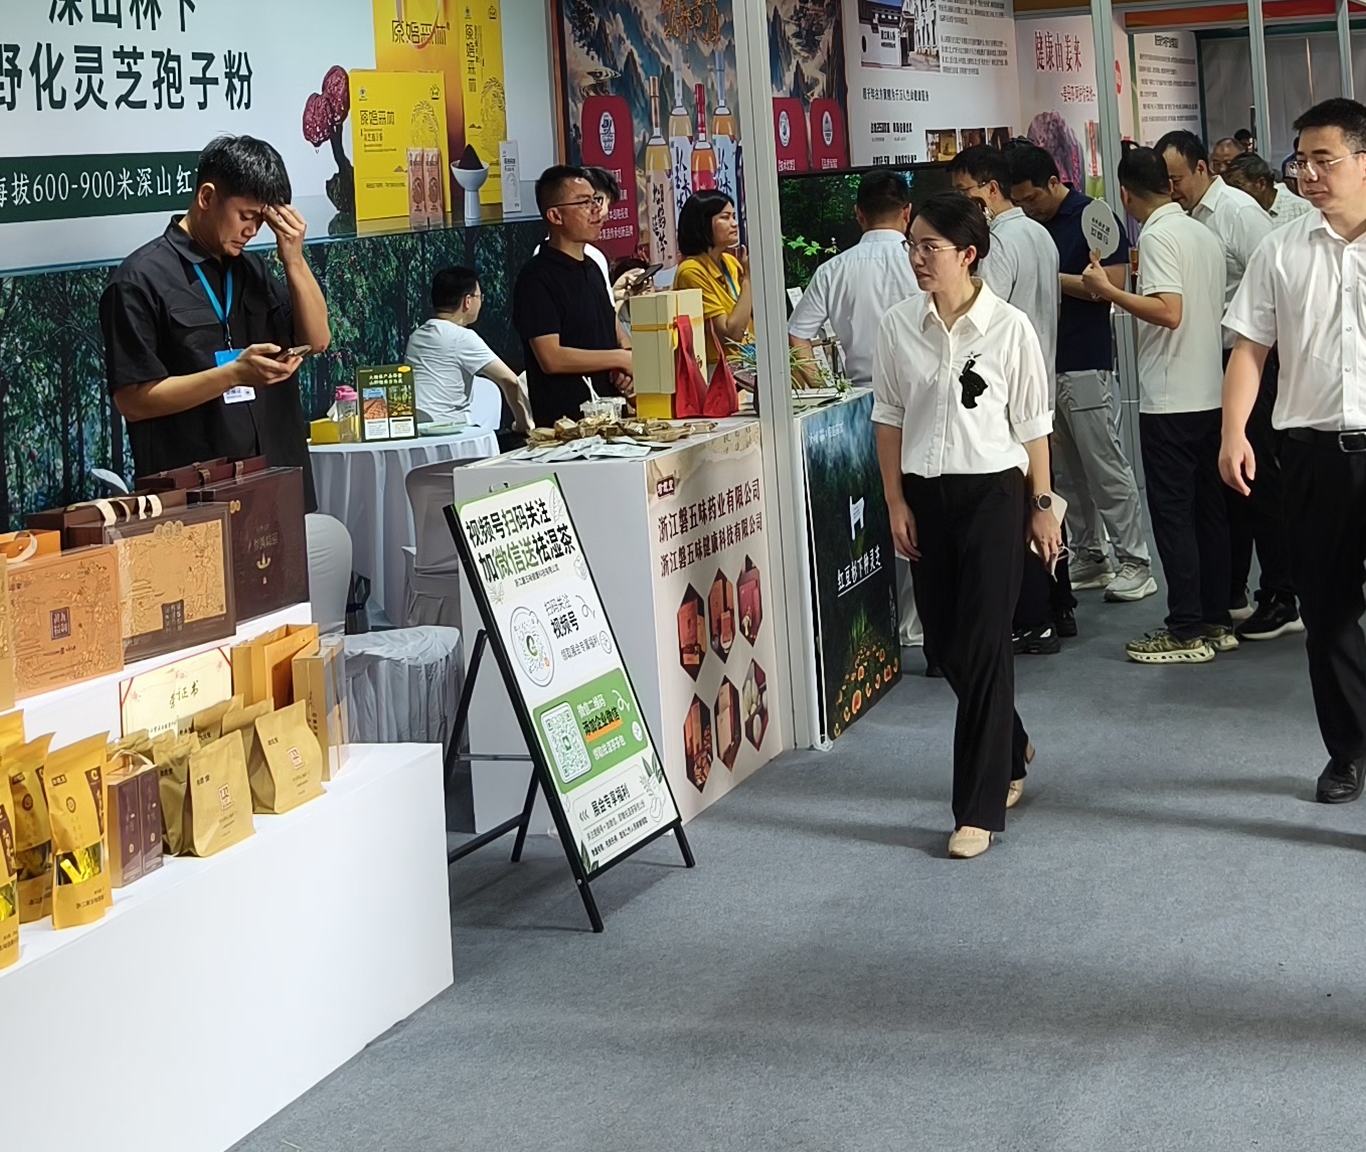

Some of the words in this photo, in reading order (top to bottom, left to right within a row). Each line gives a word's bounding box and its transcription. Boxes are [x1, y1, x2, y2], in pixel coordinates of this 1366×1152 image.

[465, 497, 552, 549] 视频号扫码关注
[658, 477, 761, 544] 浙江磐五味药业有限公司
[478, 522, 577, 583] 加微信送祛湿茶
[660, 510, 763, 578] 浙江磐五味健康科技有限公司
[550, 610, 580, 640] 视频号
